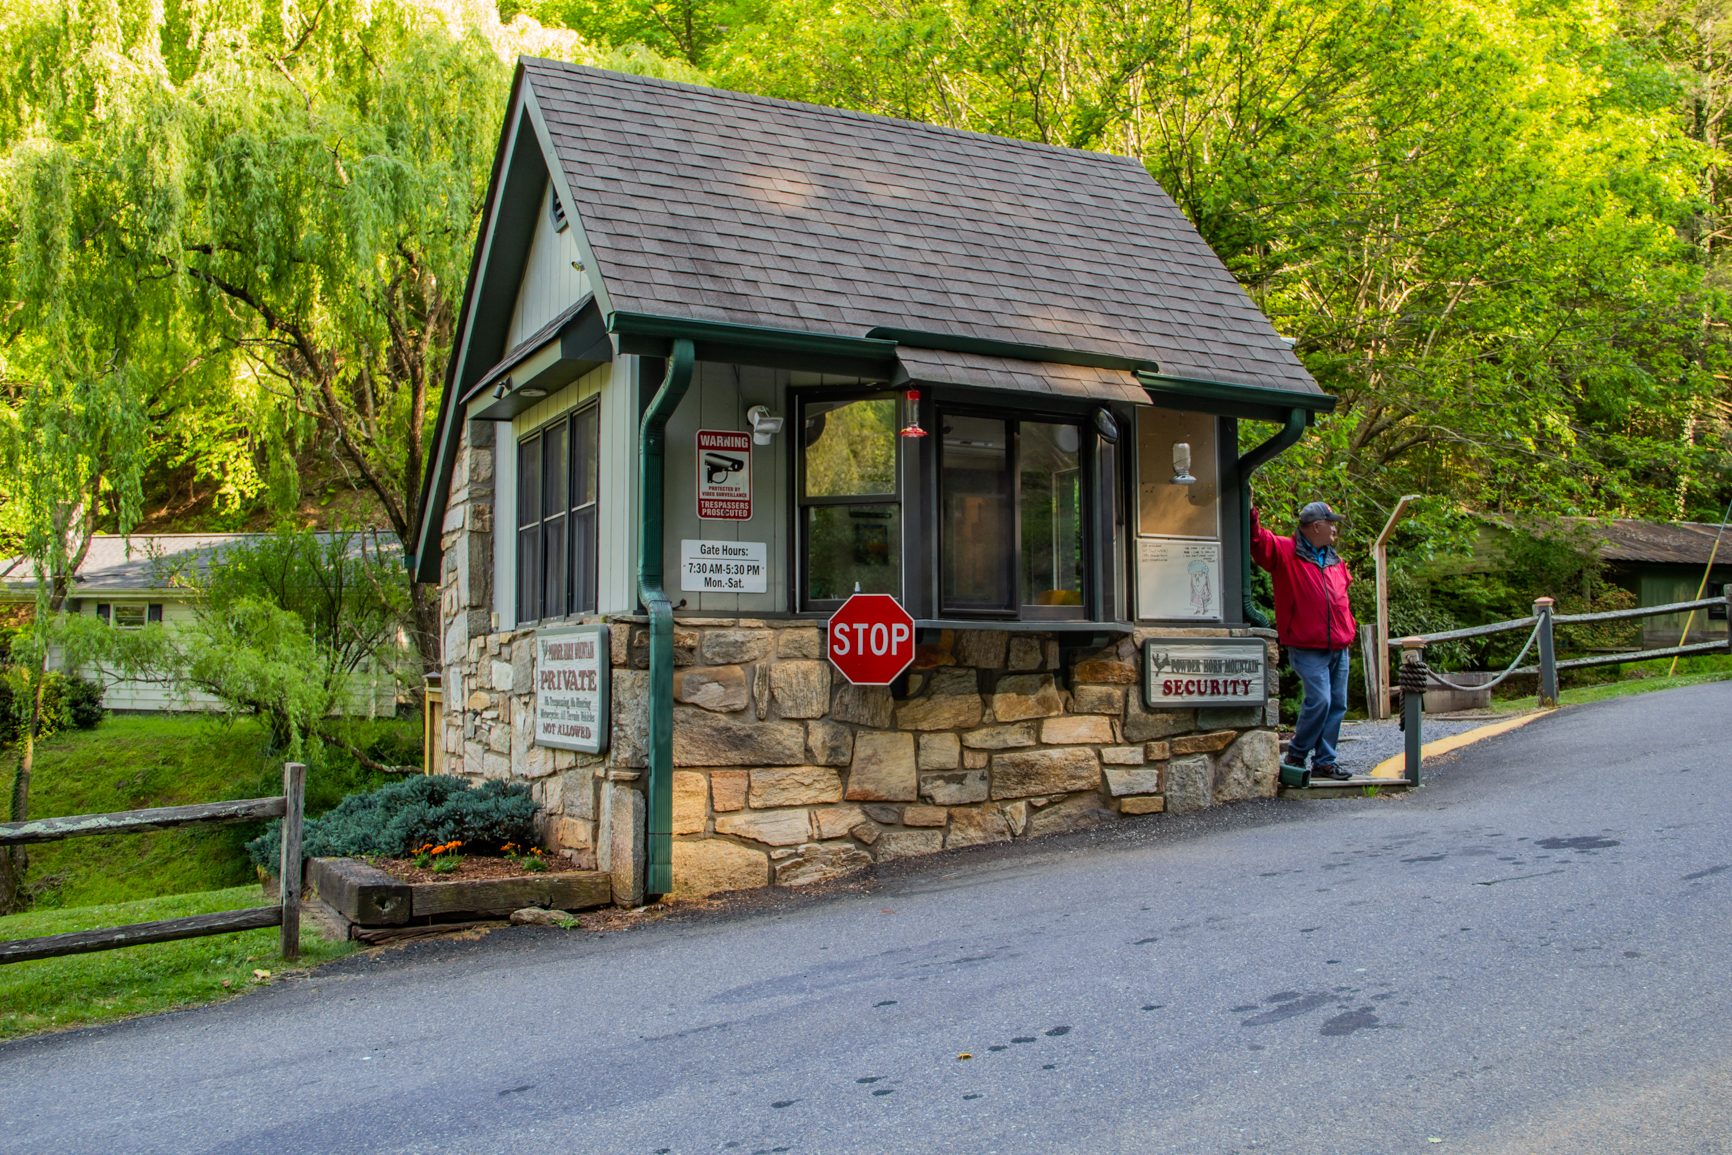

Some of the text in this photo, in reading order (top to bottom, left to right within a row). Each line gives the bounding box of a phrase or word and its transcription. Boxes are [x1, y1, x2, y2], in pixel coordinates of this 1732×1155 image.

[700, 435, 749, 448] WARNING
[701, 501, 749, 509] TRESPASSERS
[702, 508, 748, 517] PROSECUTED
[700, 544, 749, 556] Gate Hours:
[688, 563, 760, 575] 7:30 AM-5:30 PM
[704, 577, 744, 588] Mon.-Sat.
[833, 623, 910, 656] STOP
[1171, 659, 1259, 673] POWDER HORN MOUNTAIN
[540, 670, 597, 691] PRIVATE
[1162, 679, 1253, 696] SECURITY
[543, 723, 592, 739] NOT ALLOWED
